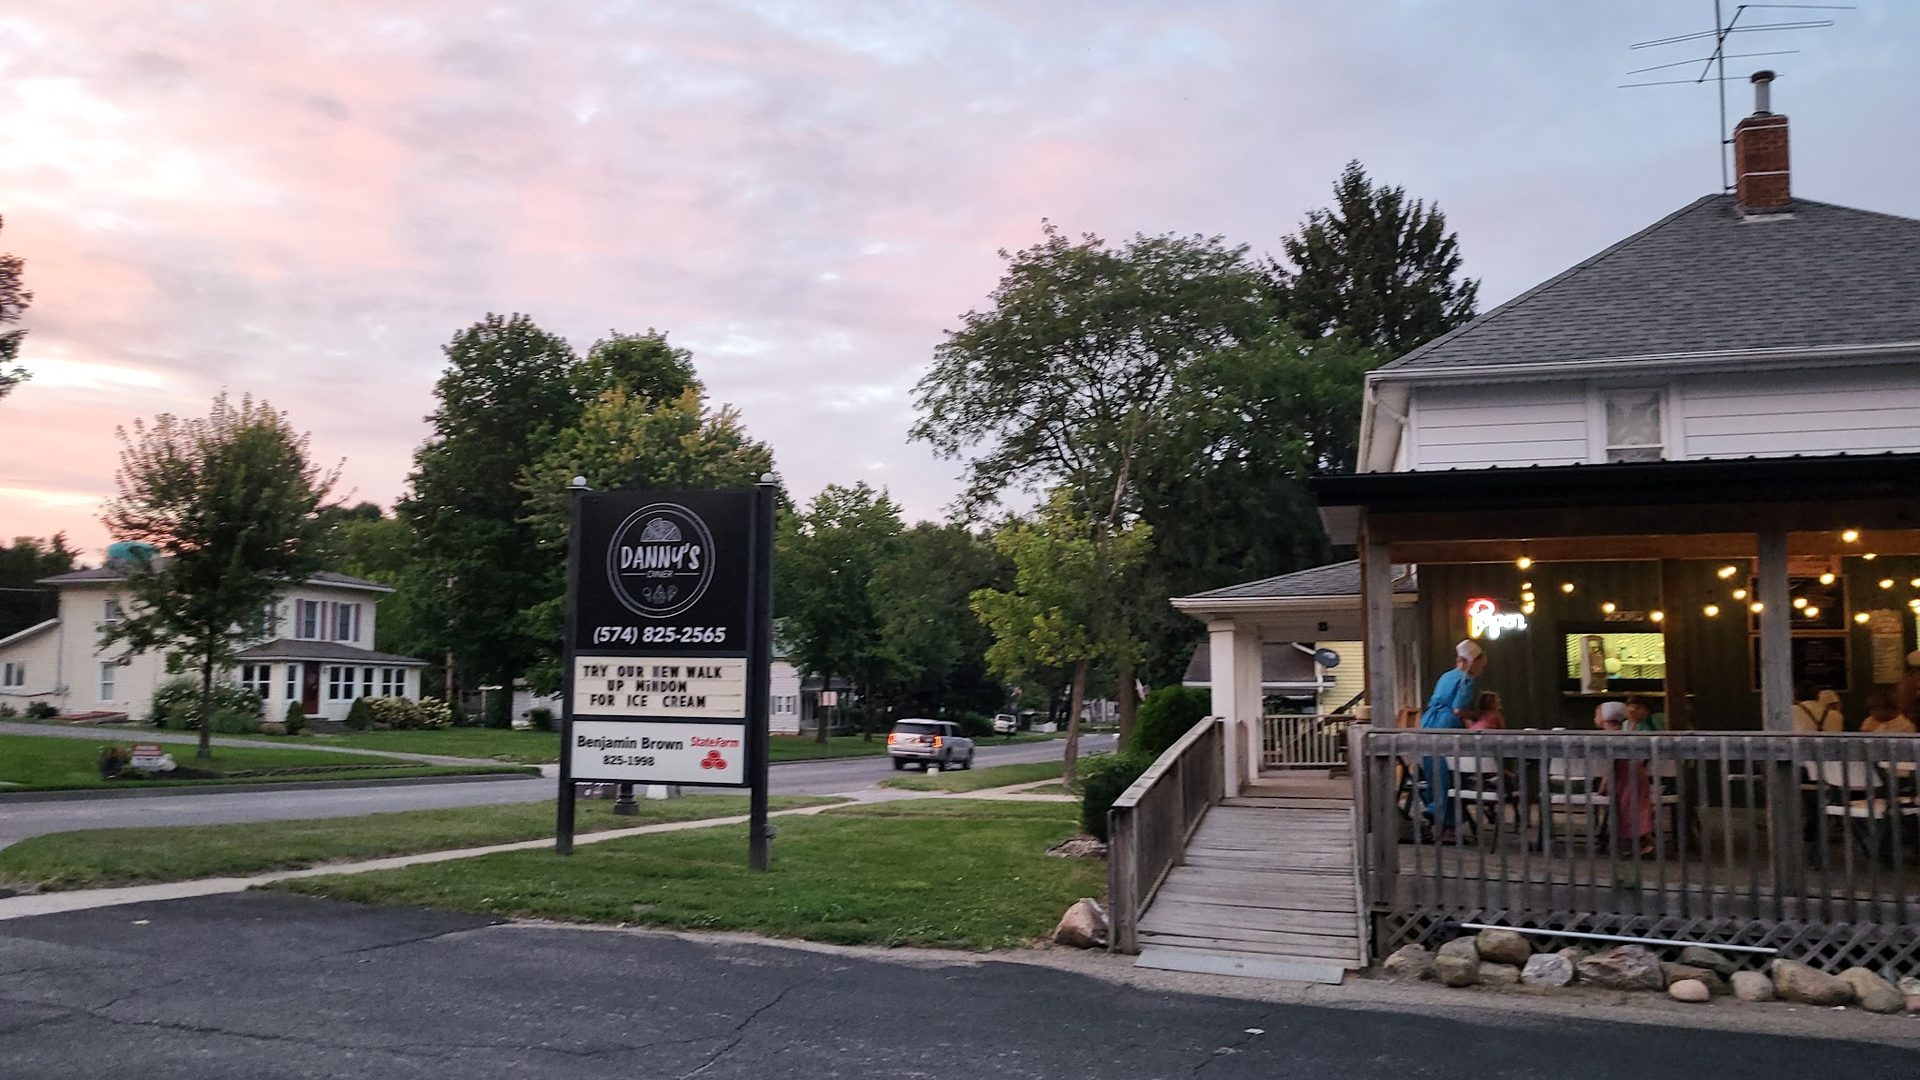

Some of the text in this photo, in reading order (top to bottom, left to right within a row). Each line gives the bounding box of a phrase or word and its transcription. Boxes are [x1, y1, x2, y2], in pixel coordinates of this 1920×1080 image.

[620, 542, 701, 570] DANNY'S
[646, 570, 674, 579] DINER
[593, 626, 727, 644] (574) 825-2565
[583, 665, 723, 679] TRY OUR NEW WALK
[607, 680, 624, 692] UP
[590, 694, 707, 708] FOR ICE CREAM
[577, 735, 684, 752] Benjamin Brown
[603, 755, 655, 766] 825-1998
